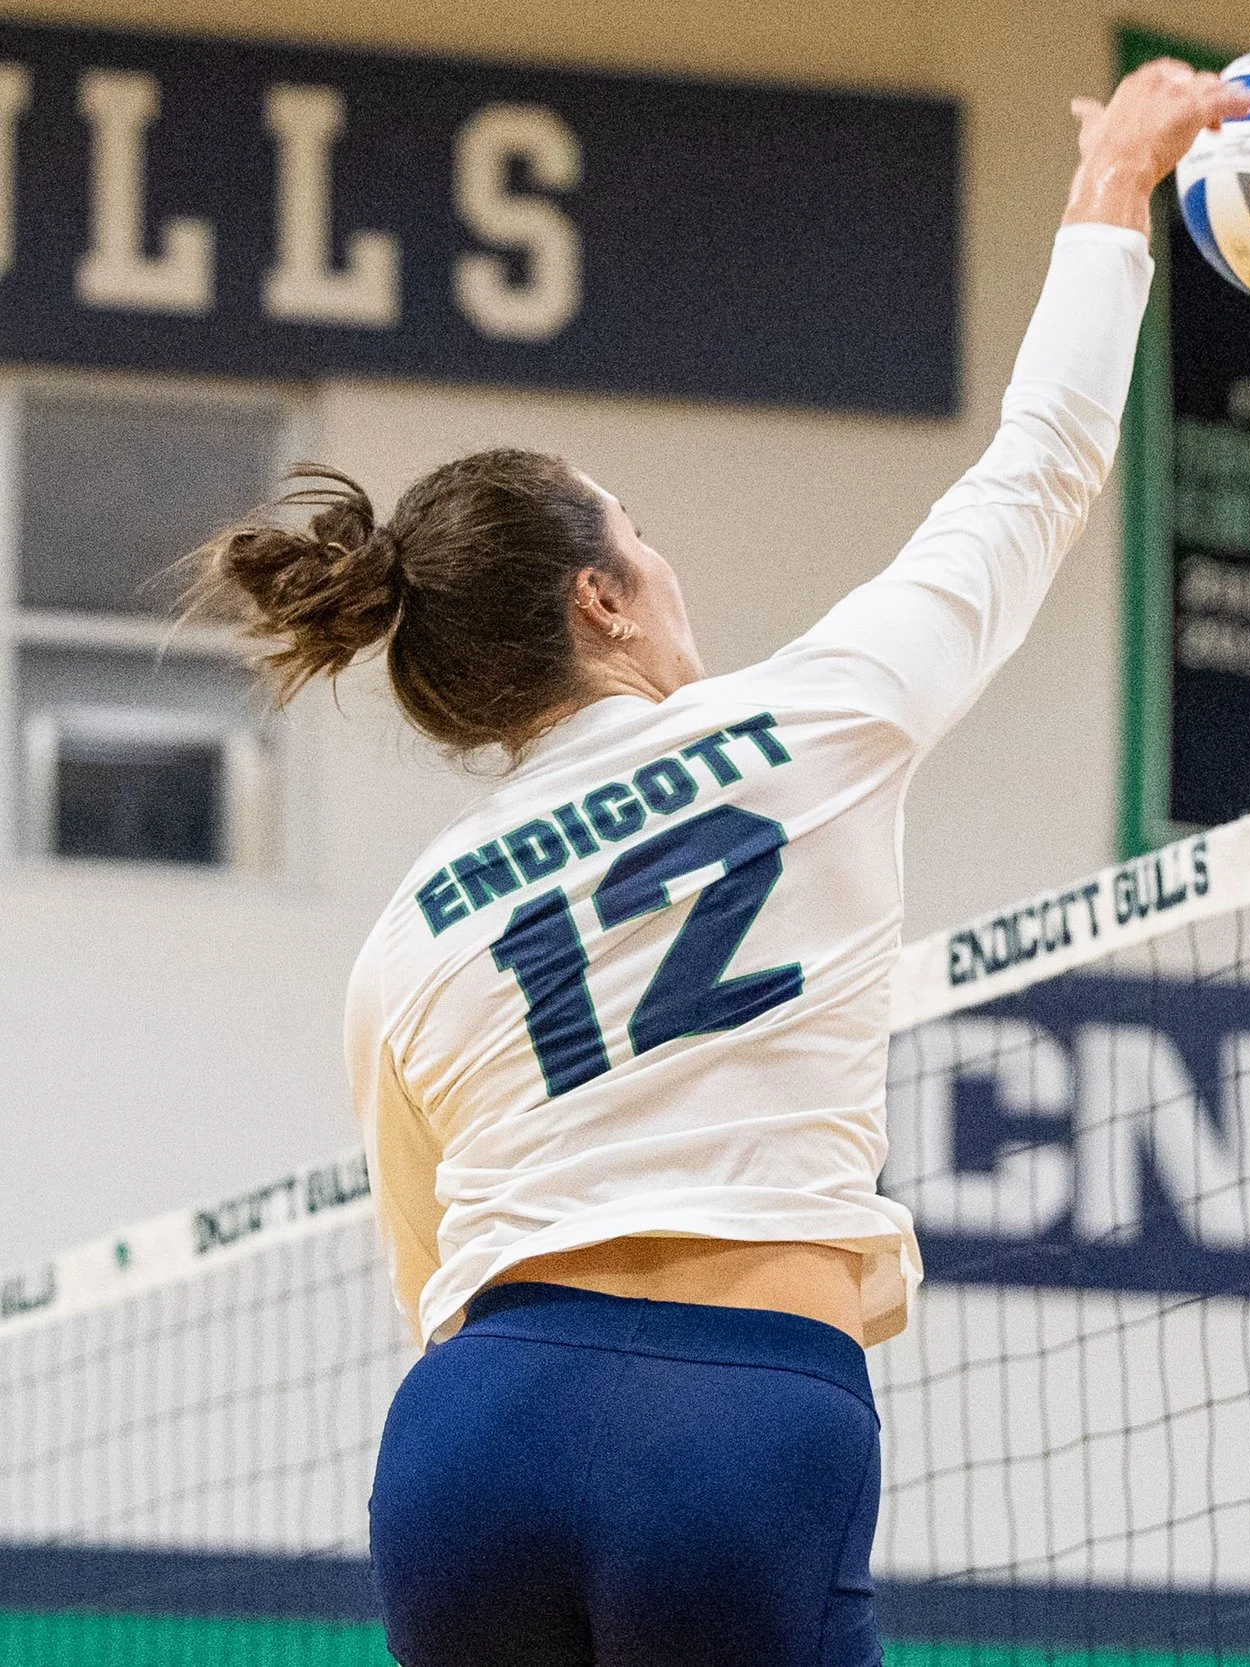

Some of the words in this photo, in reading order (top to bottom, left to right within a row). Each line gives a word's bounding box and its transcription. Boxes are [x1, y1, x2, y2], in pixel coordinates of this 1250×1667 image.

[414, 711, 793, 939] ENDICOTT
[946, 880, 1100, 989] ENDICOTT
[1112, 838, 1210, 925] GULLS
[489, 803, 806, 1099] 12
